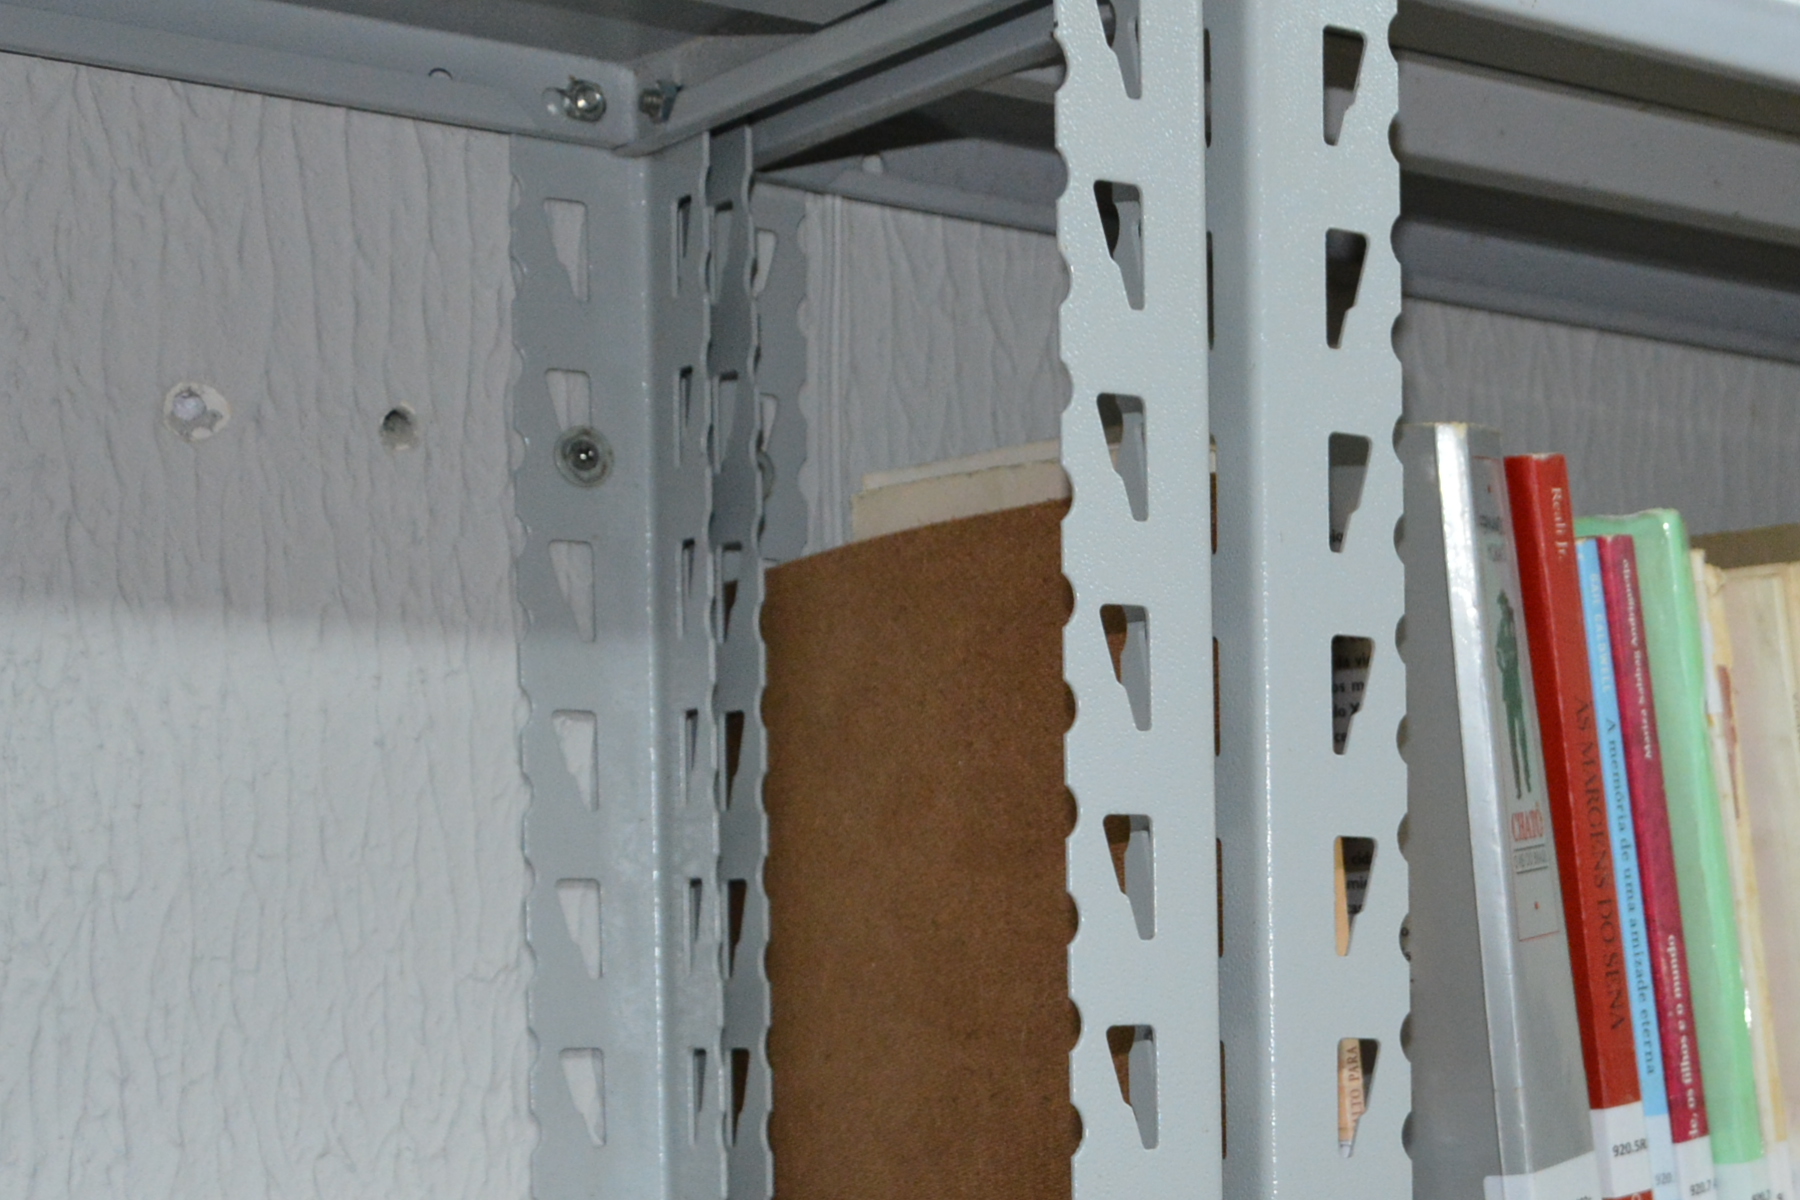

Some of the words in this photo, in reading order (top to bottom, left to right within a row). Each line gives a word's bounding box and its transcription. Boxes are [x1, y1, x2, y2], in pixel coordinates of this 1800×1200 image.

[1551, 487, 1566, 538] Reali
[1557, 540, 1568, 562] Jr.
[1605, 718, 1616, 735] A
[1607, 738, 1627, 833] memória
[1578, 733, 1612, 897] MARGENS
[1620, 837, 1632, 863] de
[1623, 869, 1636, 914] uma
[1599, 898, 1618, 947] DO
[1627, 915, 1648, 1005] amizade
[1667, 934, 1682, 999] mundo
[1603, 950, 1626, 1031] SENA
[1346, 1044, 1359, 1081] PARA
[1640, 1007, 1656, 1076] eterna
[1680, 1035, 1692, 1084] filhos
[1686, 1087, 1696, 1109] os
